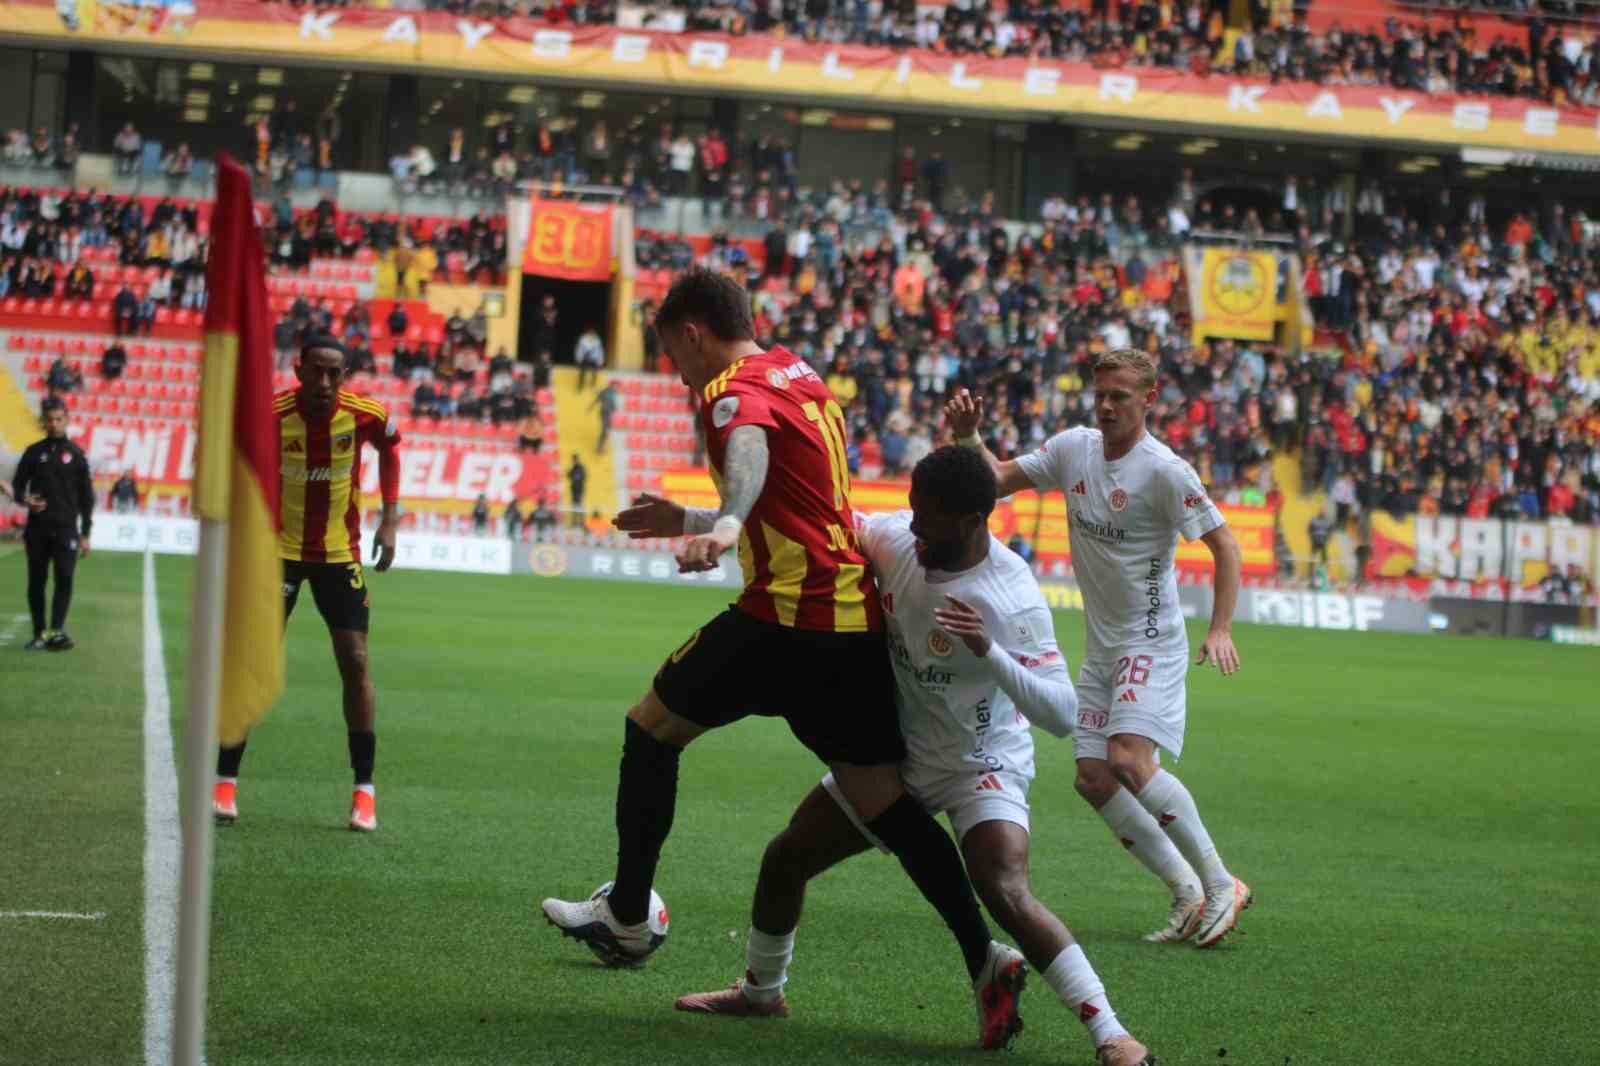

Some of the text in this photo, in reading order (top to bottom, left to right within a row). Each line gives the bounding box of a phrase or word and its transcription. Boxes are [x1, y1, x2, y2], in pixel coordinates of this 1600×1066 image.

[1226, 83, 1600, 141] KAYSE
[1414, 512, 1600, 592] KAPA
[346, 562, 364, 590] 3
[1115, 655, 1153, 688] 26
